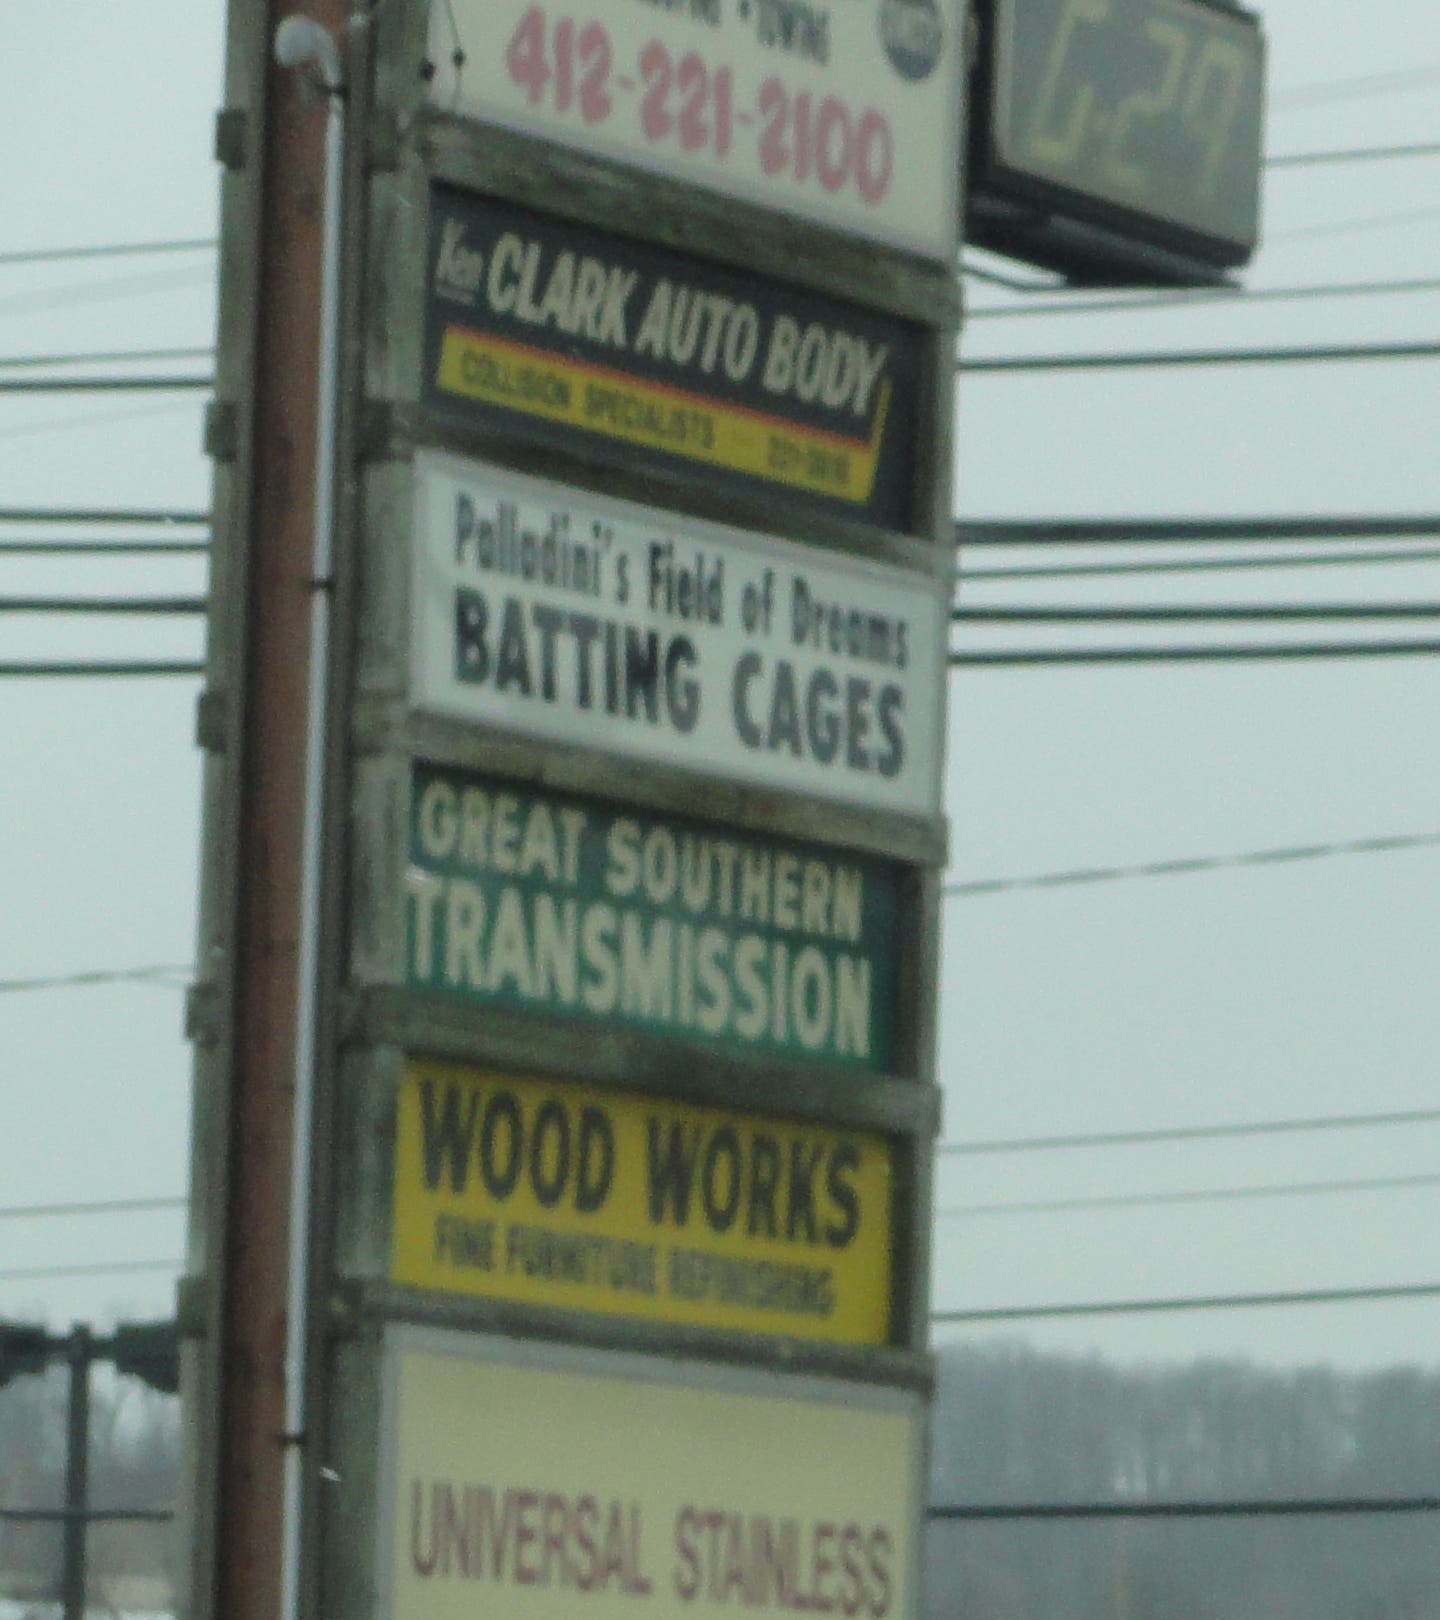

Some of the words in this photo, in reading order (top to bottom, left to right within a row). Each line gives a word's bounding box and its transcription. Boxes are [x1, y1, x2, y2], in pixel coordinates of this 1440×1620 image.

[507, 5, 893, 205] 412-221-2100
[486, 233, 637, 348] CLARK
[635, 280, 759, 382] AUTO
[763, 315, 888, 416] BODY
[454, 586, 700, 734] BATTING
[732, 651, 905, 779] CAGES
[648, 541, 724, 626] Field
[742, 567, 773, 634] of
[791, 576, 908, 670] Dreams
[420, 780, 588, 884] GREAT
[605, 817, 864, 941] SOUTHERN
[407, 879, 873, 1058] TRANSMISSION
[418, 1080, 616, 1212] WOOD
[645, 1113, 861, 1250] WORKS
[410, 1479, 651, 1595] UNIVERSAL
[673, 1504, 894, 1620] STAINLESS
